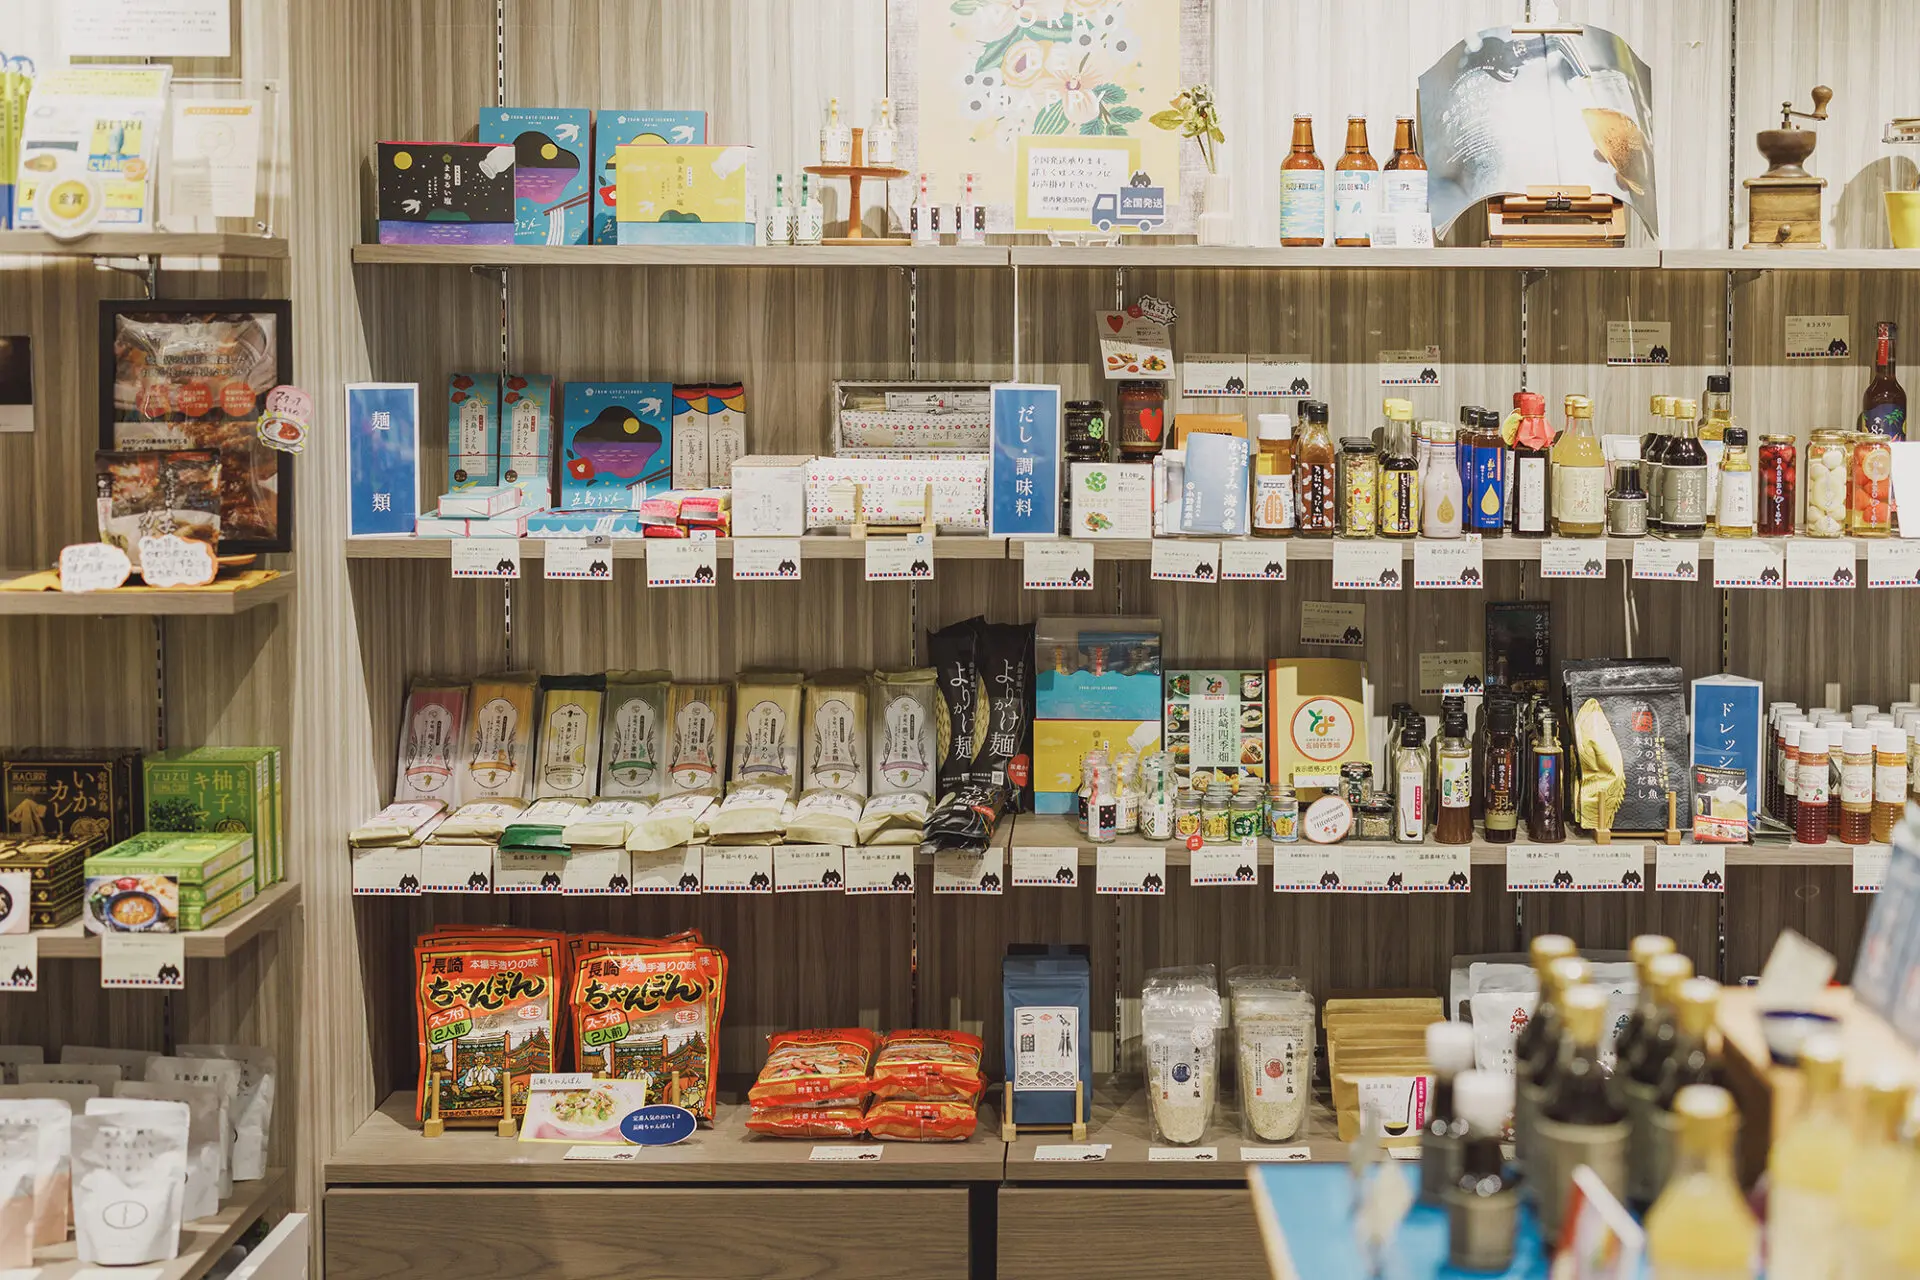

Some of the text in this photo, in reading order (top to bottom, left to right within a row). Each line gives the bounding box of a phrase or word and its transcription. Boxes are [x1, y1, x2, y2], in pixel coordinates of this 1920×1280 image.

[1122, 196, 1164, 208] 全国発送
[522, 415, 530, 450] 五島うどん
[1015, 404, 1036, 518] だし・調味料
[988, 658, 1019, 757] よりかけ麺
[1218, 706, 1229, 763] 長崎四季畑
[153, 773, 189, 781] YUZU
[1632, 736, 1646, 799] 本クエだし
[1643, 737, 1659, 800] 幻の高級魚
[1705, 776, 1741, 787] 本クエだし
[48, 779, 73, 838] カレー
[72, 769, 97, 813] いか
[193, 772, 212, 832] キーマ
[212, 769, 233, 814] 柚子
[1312, 811, 1345, 830] Hitotema
[431, 956, 539, 975] 長崎 本場手造りの味
[588, 960, 698, 978] 長崎 本場手造りの味
[427, 970, 546, 1010] ちゃんぽん
[584, 973, 704, 1012] ちゃんぽん
[430, 1007, 466, 1027] スープ付
[520, 1006, 541, 1017] 半生
[584, 1010, 622, 1030] スープ付
[677, 1011, 698, 1023] 半生
[433, 1021, 466, 1040] 2人前
[590, 1026, 624, 1042] 2人前
[532, 1076, 582, 1086] 長崎ちゃんぽん
[1192, 1047, 1201, 1098] あごのだし塩
[1285, 1042, 1294, 1094] 真鯛のだし塩
